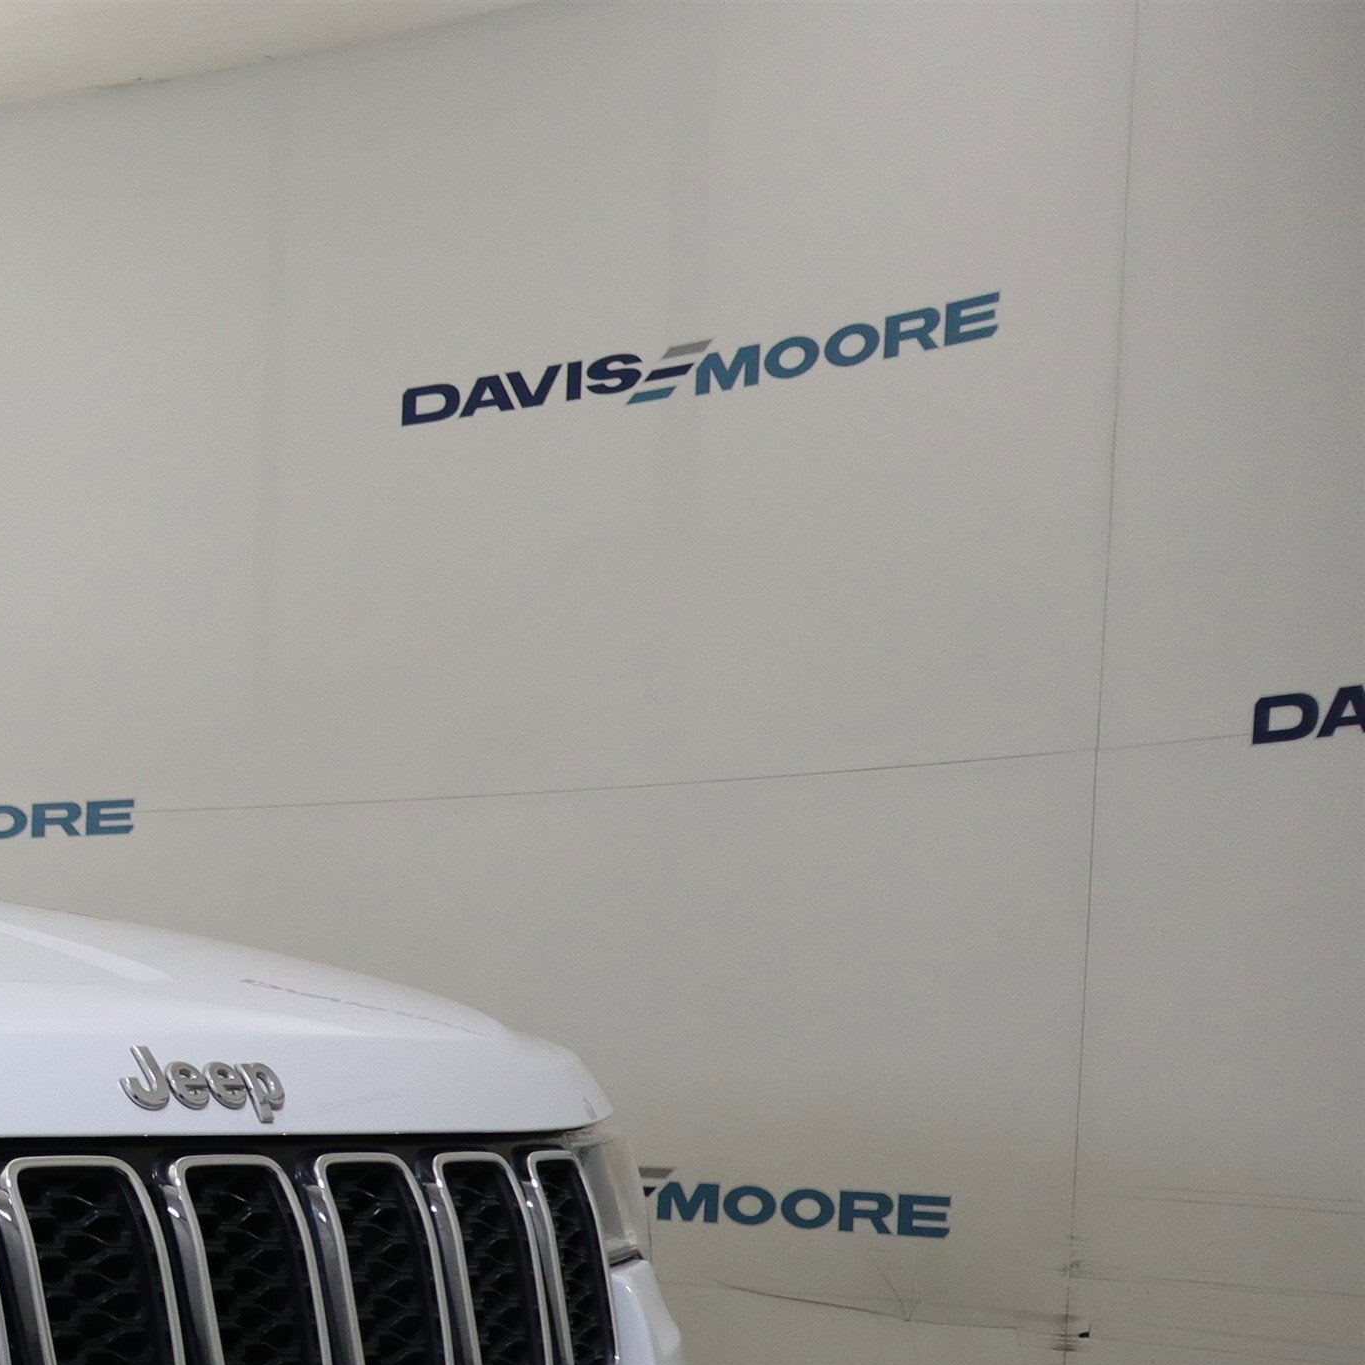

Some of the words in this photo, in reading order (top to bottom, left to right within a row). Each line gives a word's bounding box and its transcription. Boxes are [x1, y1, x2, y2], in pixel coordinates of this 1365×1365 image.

[401, 352, 643, 426] DAVIS
[694, 291, 1001, 396] MOORE
[119, 1045, 286, 1124] Jeep
[656, 1181, 951, 1238] MOORE
